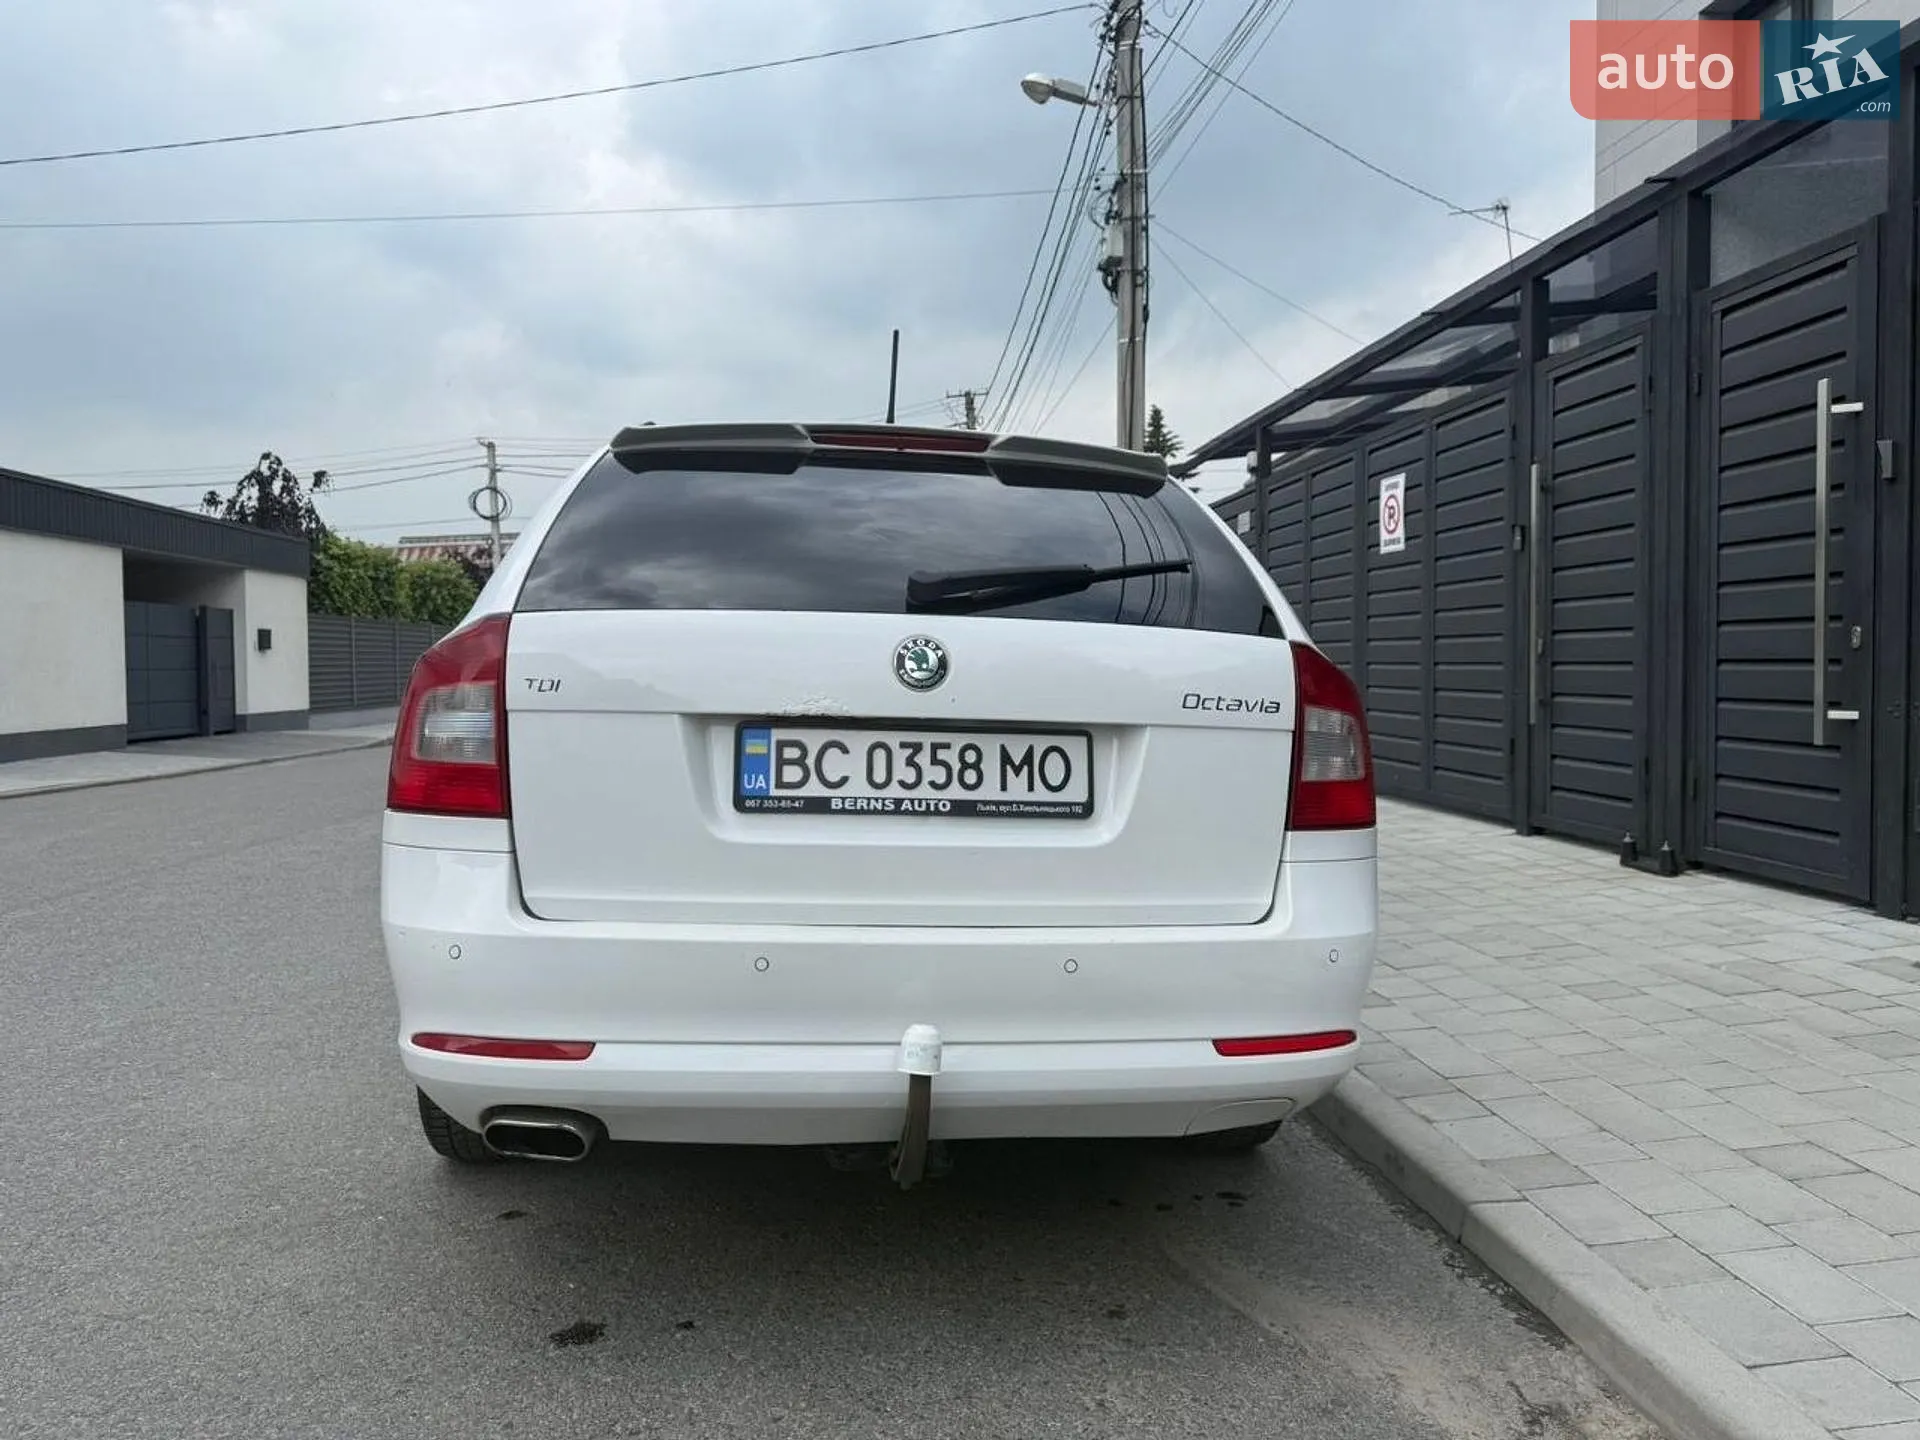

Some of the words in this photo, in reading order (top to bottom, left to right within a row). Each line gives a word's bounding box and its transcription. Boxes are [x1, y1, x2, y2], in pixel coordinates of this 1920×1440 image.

[524, 678, 561, 693] TDI
[1182, 693, 1281, 714] Octavia
[775, 739, 850, 790] BC
[866, 741, 984, 791] 0358
[1000, 744, 1072, 793] MO
[744, 773, 767, 789] UA
[831, 798, 895, 811] BERNS
[901, 799, 951, 812] AUTO
